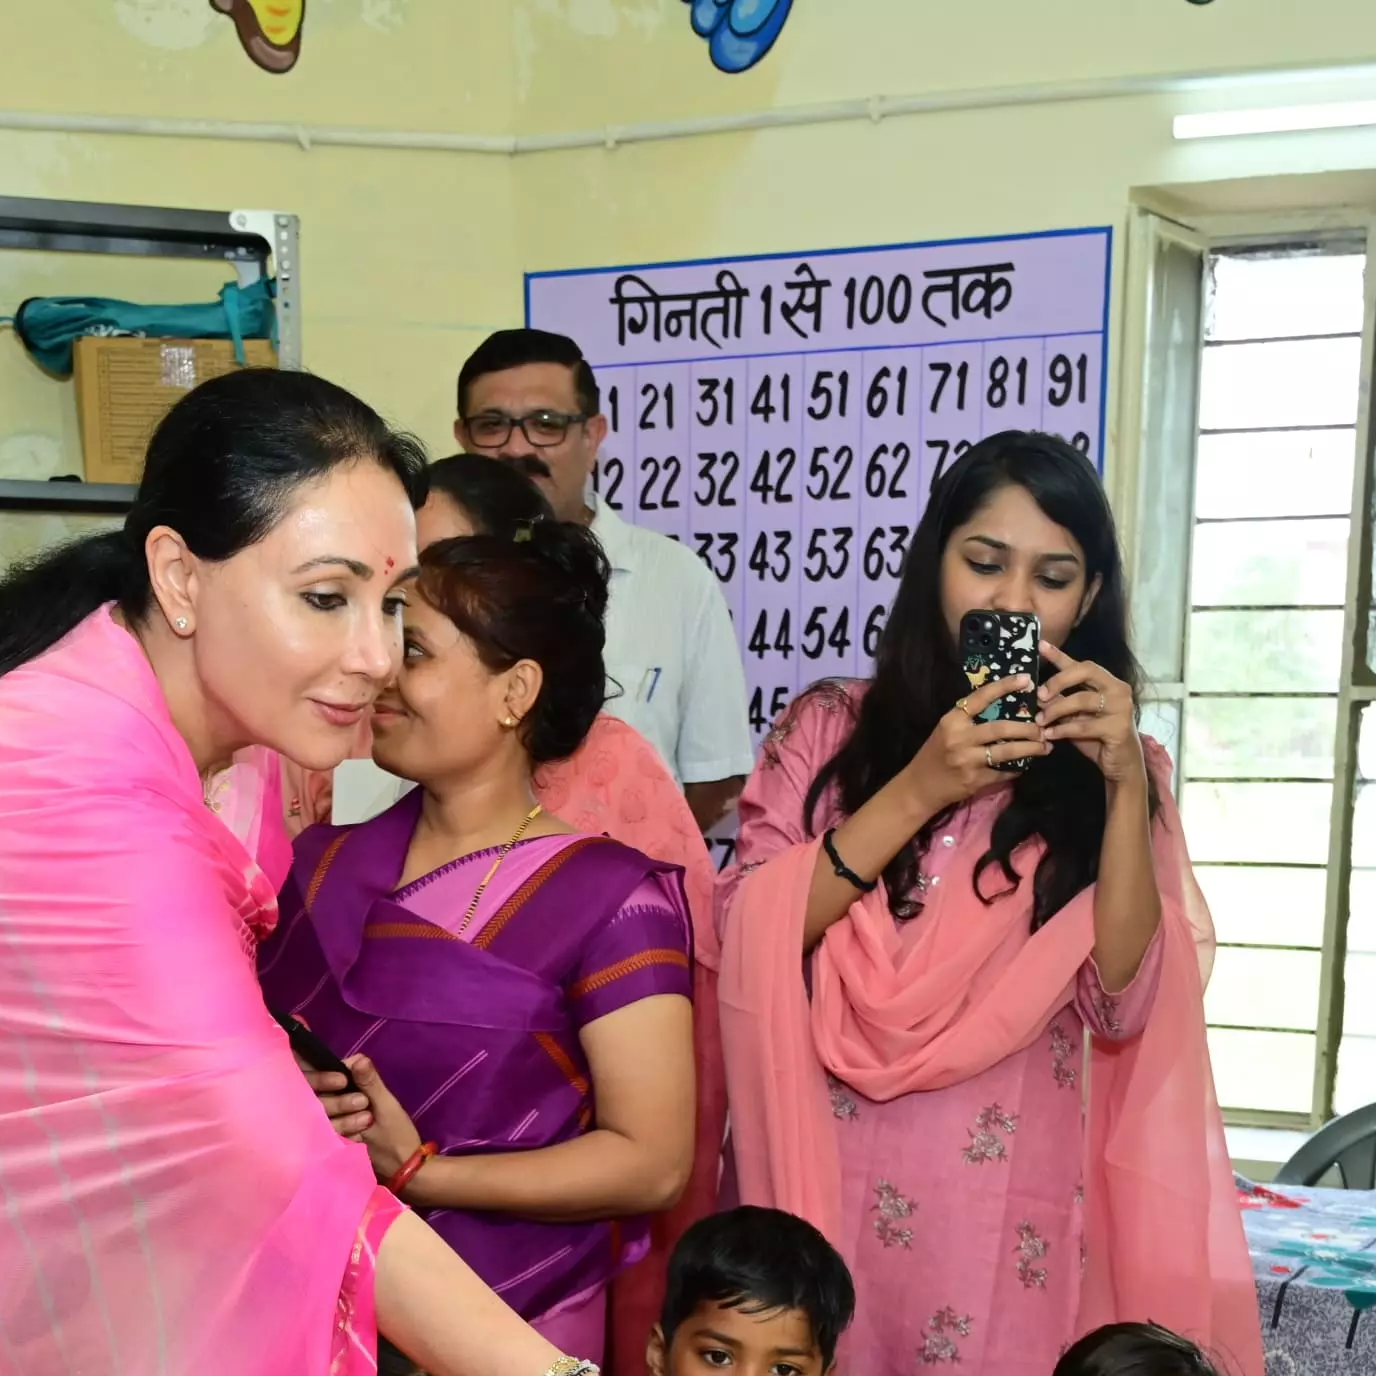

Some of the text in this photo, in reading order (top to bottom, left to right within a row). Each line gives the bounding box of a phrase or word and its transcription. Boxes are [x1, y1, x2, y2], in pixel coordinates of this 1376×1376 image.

[609, 262, 1015, 349] गिनती 1 से 100 तक
[639, 382, 673, 430] 21
[696, 377, 734, 426] 31
[750, 373, 790, 423] 41
[807, 370, 849, 420] 51
[866, 366, 908, 418] 61
[928, 361, 968, 413] 71
[986, 356, 1027, 408] 81
[1048, 353, 1087, 407] 91
[639, 456, 681, 511] 22
[694, 451, 740, 507] 32
[750, 447, 796, 504] 42
[806, 446, 853, 500] 52
[865, 442, 910, 499] 62
[749, 530, 792, 583] 43
[804, 526, 853, 583] 53
[863, 526, 910, 581] 63
[748, 608, 794, 660] 44
[801, 605, 851, 660] 54
